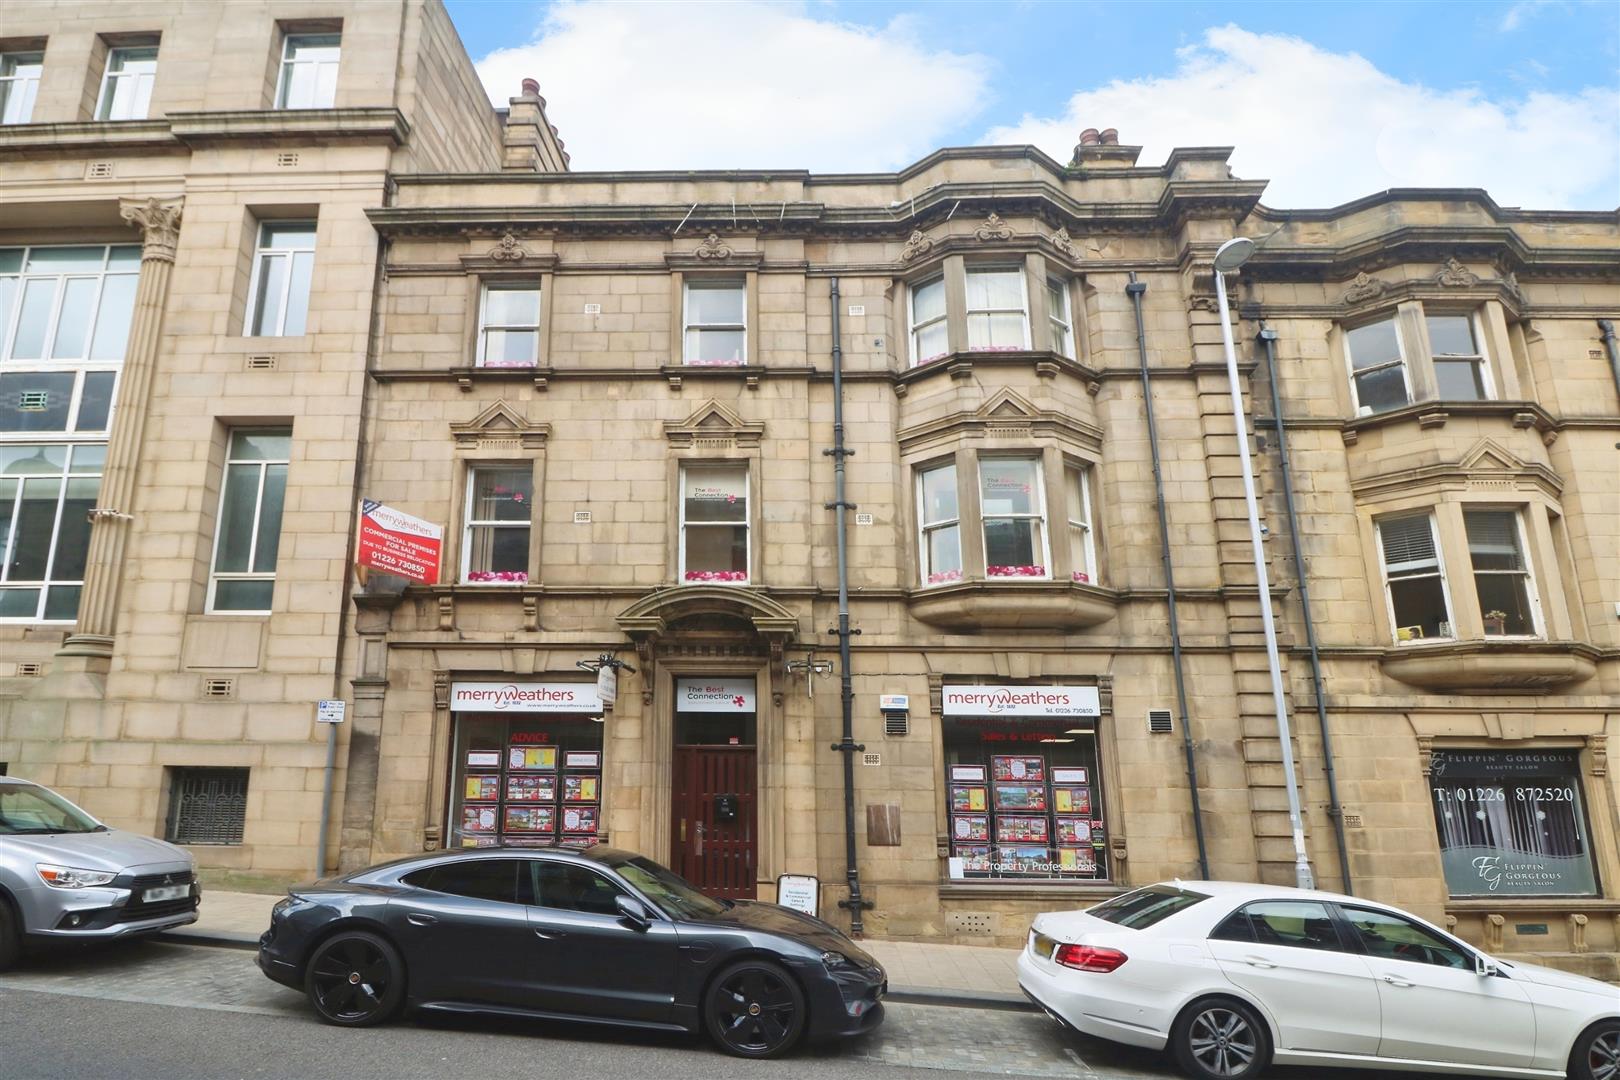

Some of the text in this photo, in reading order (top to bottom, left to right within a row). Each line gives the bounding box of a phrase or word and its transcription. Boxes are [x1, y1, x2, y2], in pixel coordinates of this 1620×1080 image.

[371, 510, 433, 537] merryweathers
[364, 526, 437, 556] COMMERCIAL PREMISES
[385, 540, 417, 556] FOR SALE
[362, 540, 374, 548] DUE
[383, 546, 406, 558] BUSINESS
[406, 554, 436, 567] RELOCATION
[371, 551, 426, 574] 01226 730850
[370, 560, 425, 580] merryweathers.co.uk
[457, 686, 574, 705] merryweathers
[948, 690, 1070, 708] merryweathers
[511, 733, 548, 743] ADVICE
[1433, 787, 1574, 802] T: 01226 872520
[984, 861, 1029, 873] Property
[1032, 861, 1097, 872] Professionals
